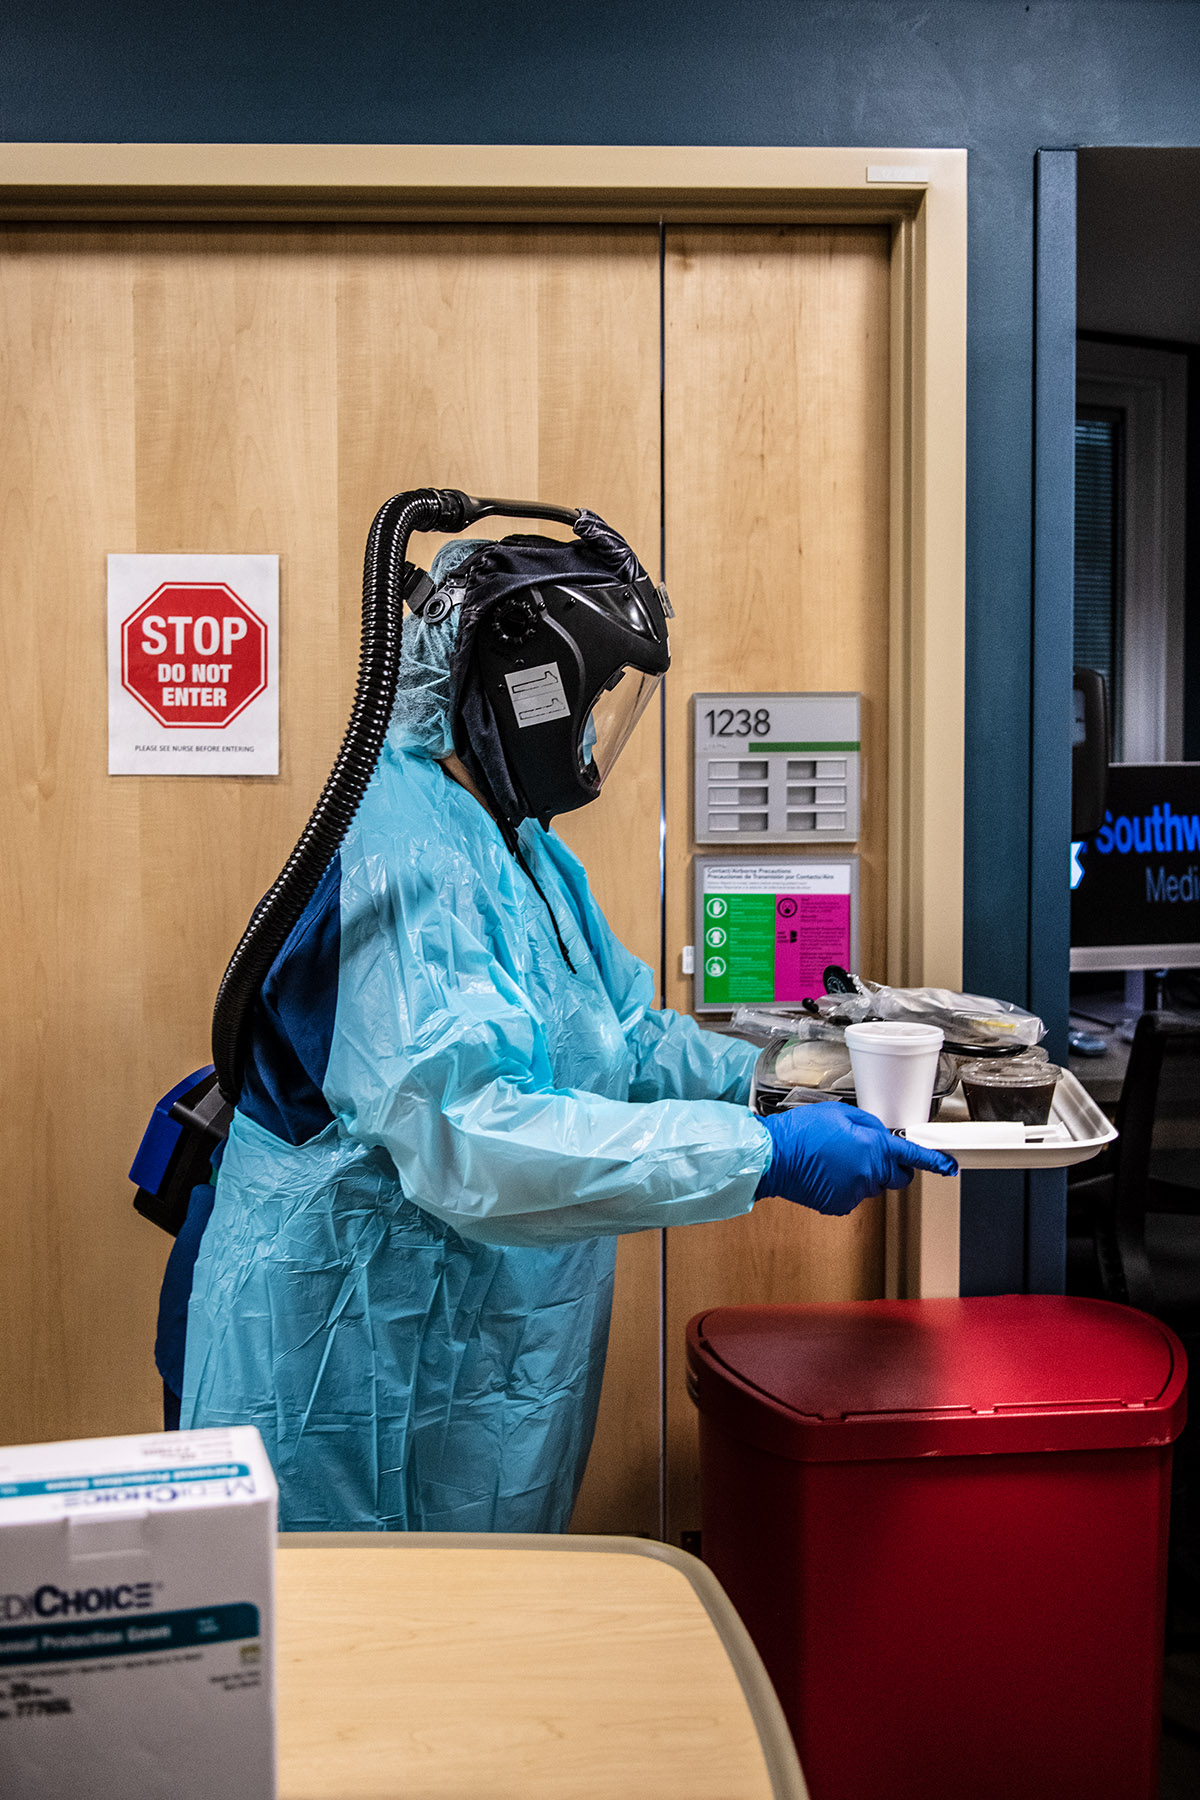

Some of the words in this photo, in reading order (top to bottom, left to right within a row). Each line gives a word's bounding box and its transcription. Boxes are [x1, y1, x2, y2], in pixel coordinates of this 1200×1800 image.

[141, 615, 248, 656] STOP
[158, 663, 186, 683] DO
[192, 663, 232, 683] NOT
[162, 687, 227, 707] ENTER
[704, 708, 771, 737] 1238
[135, 744, 157, 752] PLEASE
[159, 744, 170, 752] SEE
[222, 745, 254, 753] ENTERING
